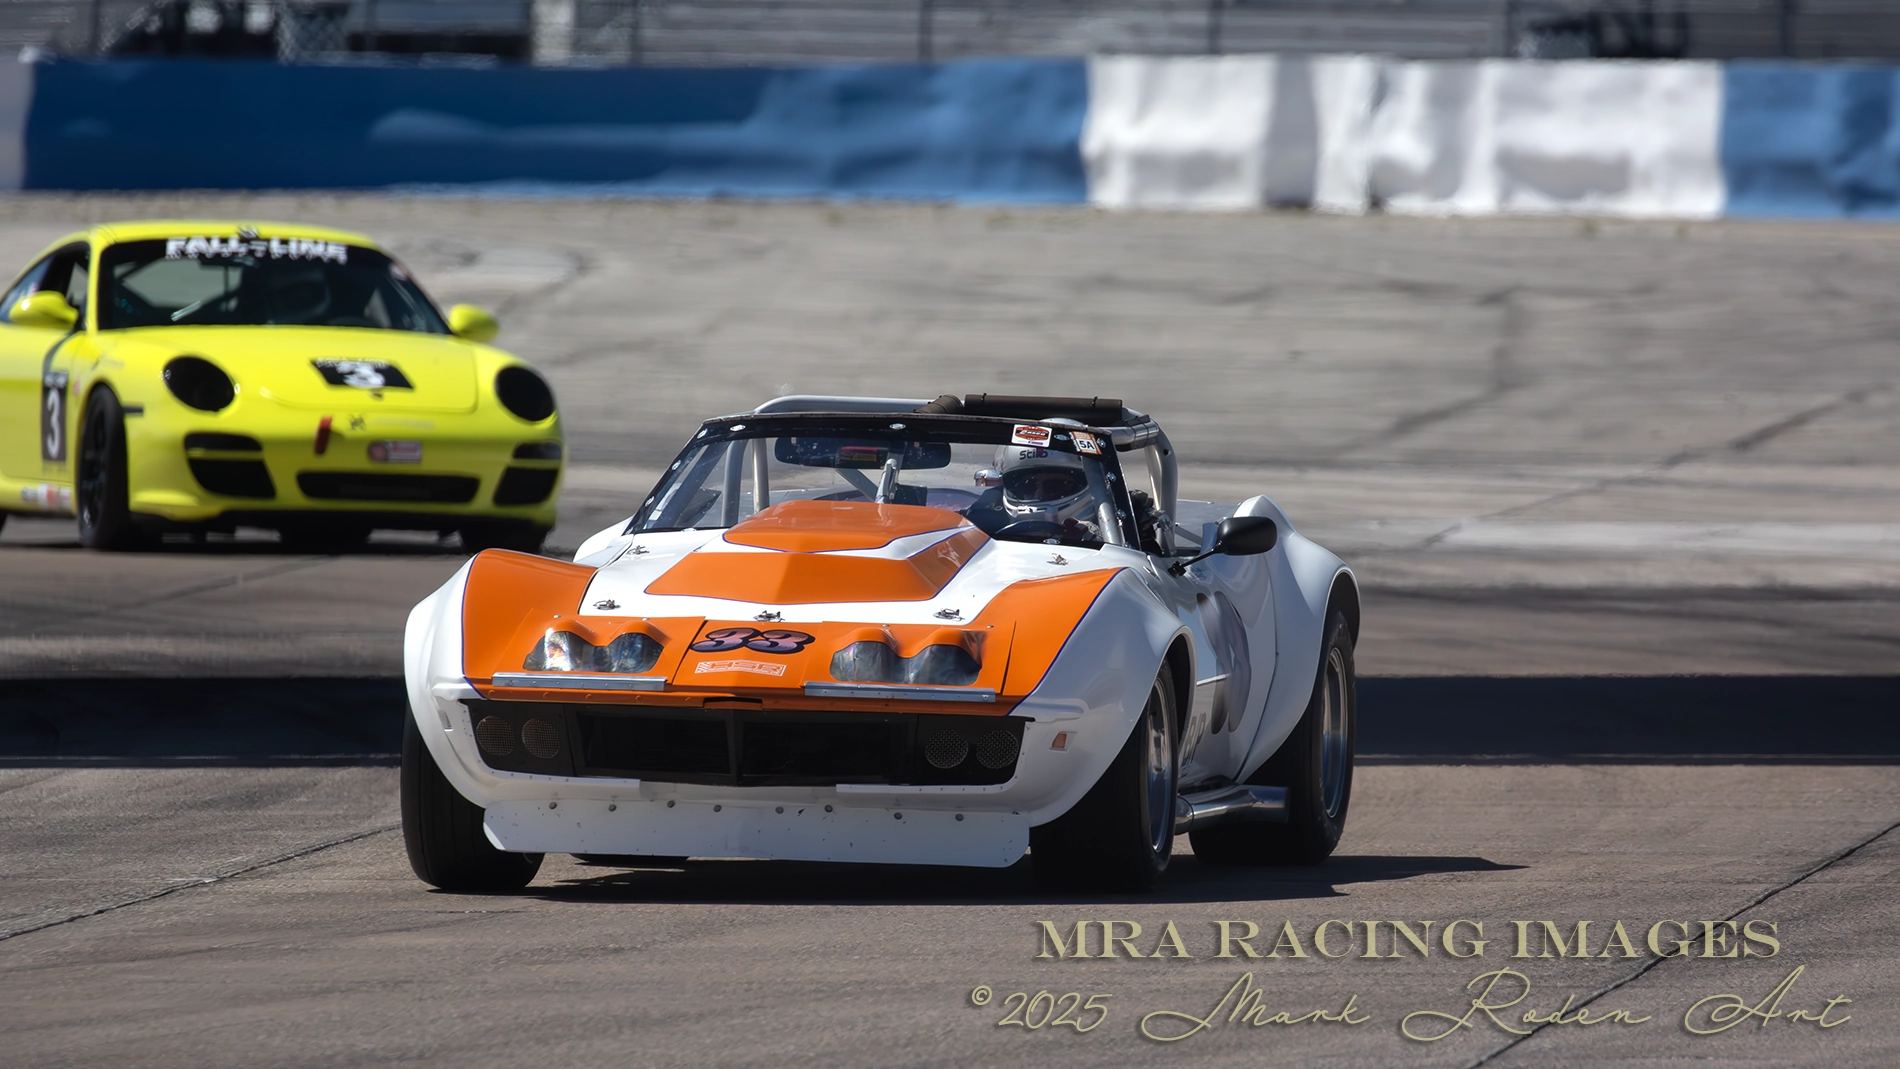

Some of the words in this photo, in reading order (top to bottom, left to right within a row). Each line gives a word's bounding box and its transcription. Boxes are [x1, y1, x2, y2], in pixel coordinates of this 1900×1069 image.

[166, 235, 348, 256] FALL-LINE
[336, 361, 385, 389] 3
[47, 387, 60, 459] 3
[1079, 440, 1095, 450] 5A
[689, 627, 816, 655] 33
[709, 660, 783, 675] HSR
